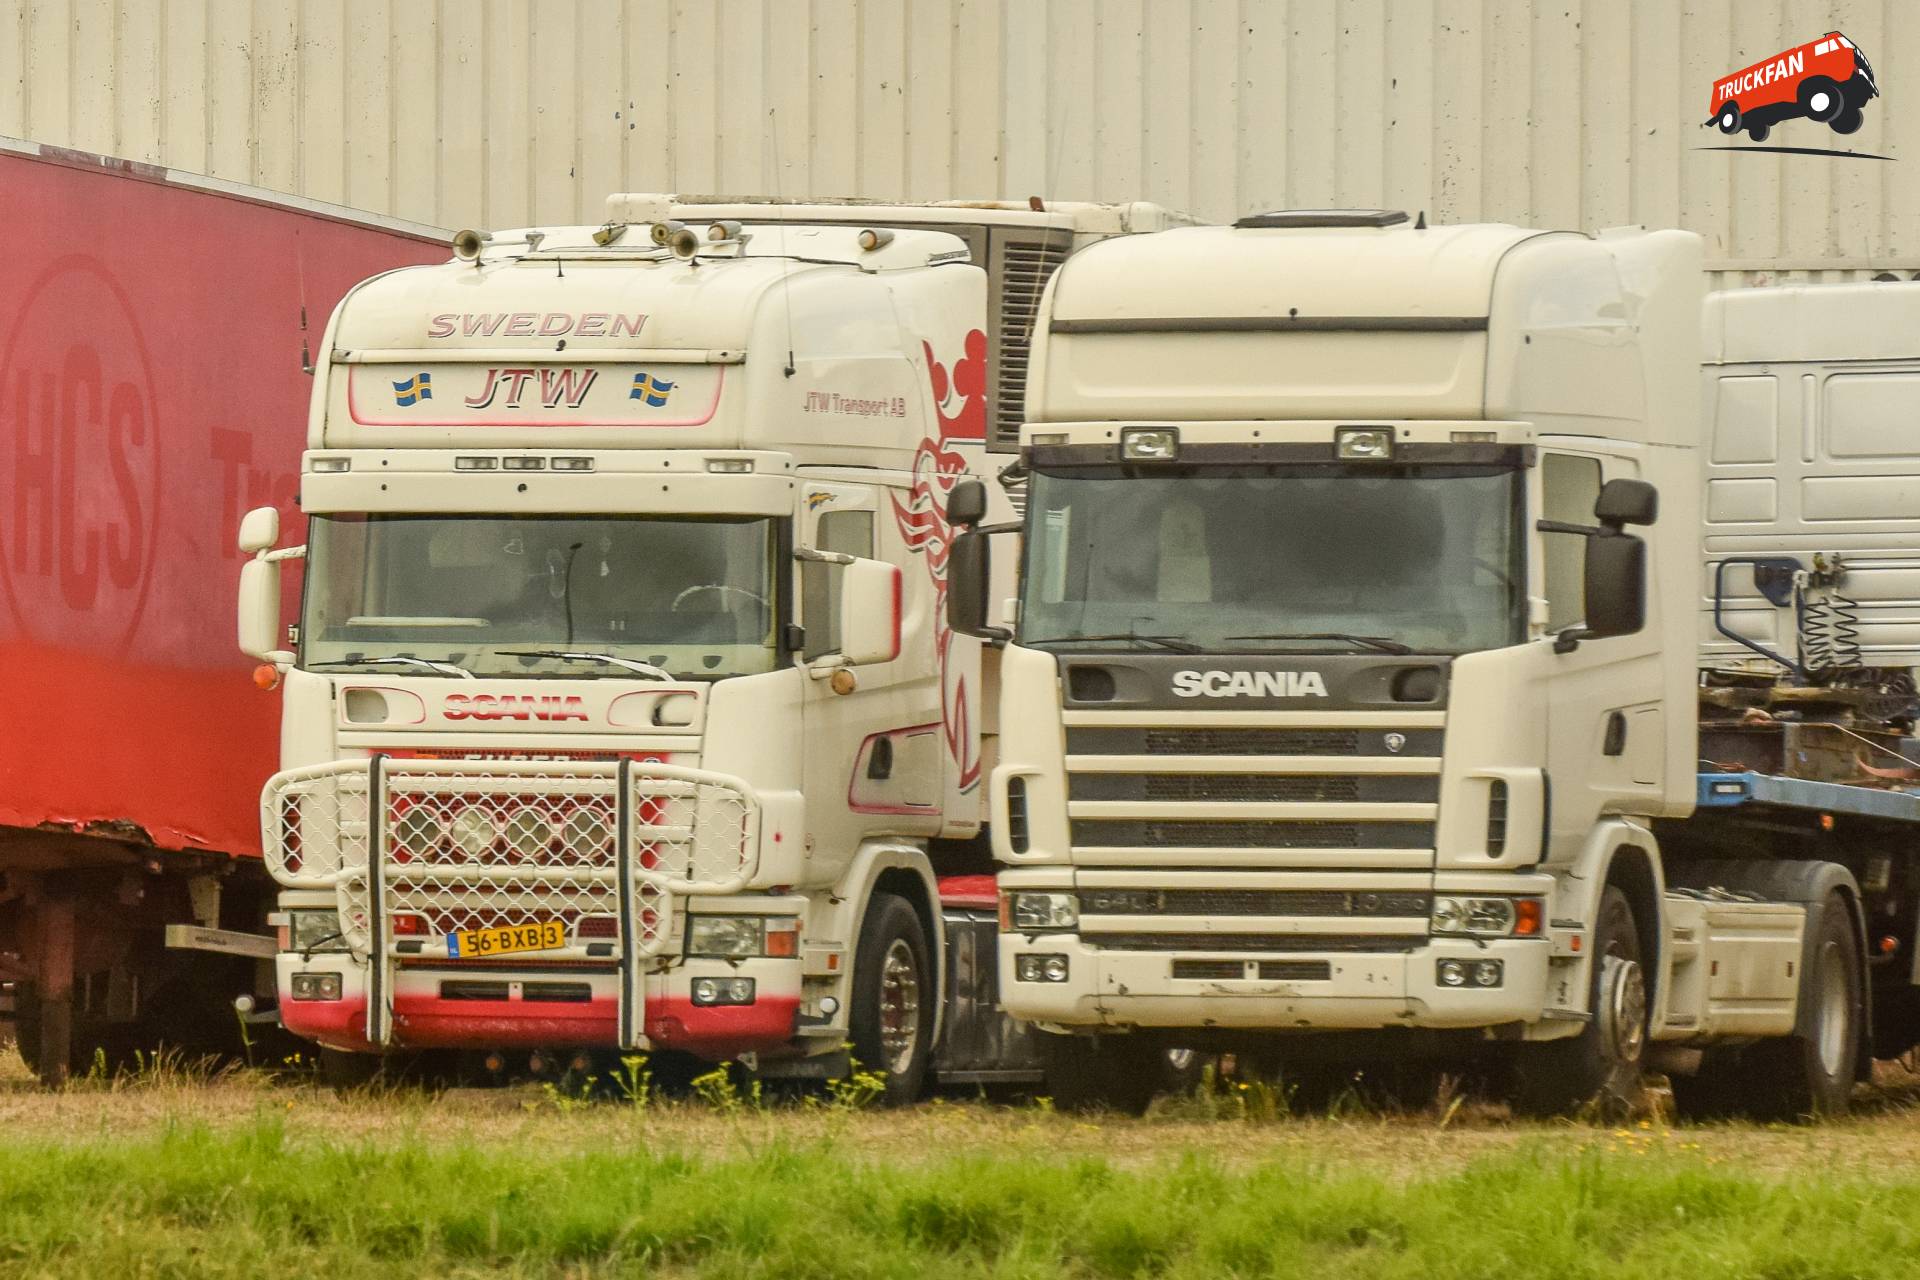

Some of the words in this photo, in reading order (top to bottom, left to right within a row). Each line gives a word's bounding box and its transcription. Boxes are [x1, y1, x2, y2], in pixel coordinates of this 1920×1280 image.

[428, 312, 648, 338] SWEDEN
[465, 368, 598, 408] JTW
[804, 391, 830, 412] JTW
[832, 393, 888, 419] Transport
[890, 397, 906, 417] AB
[14, 344, 145, 611] HCS
[1171, 670, 1328, 697] SCANIA
[443, 694, 589, 721] SCANIA
